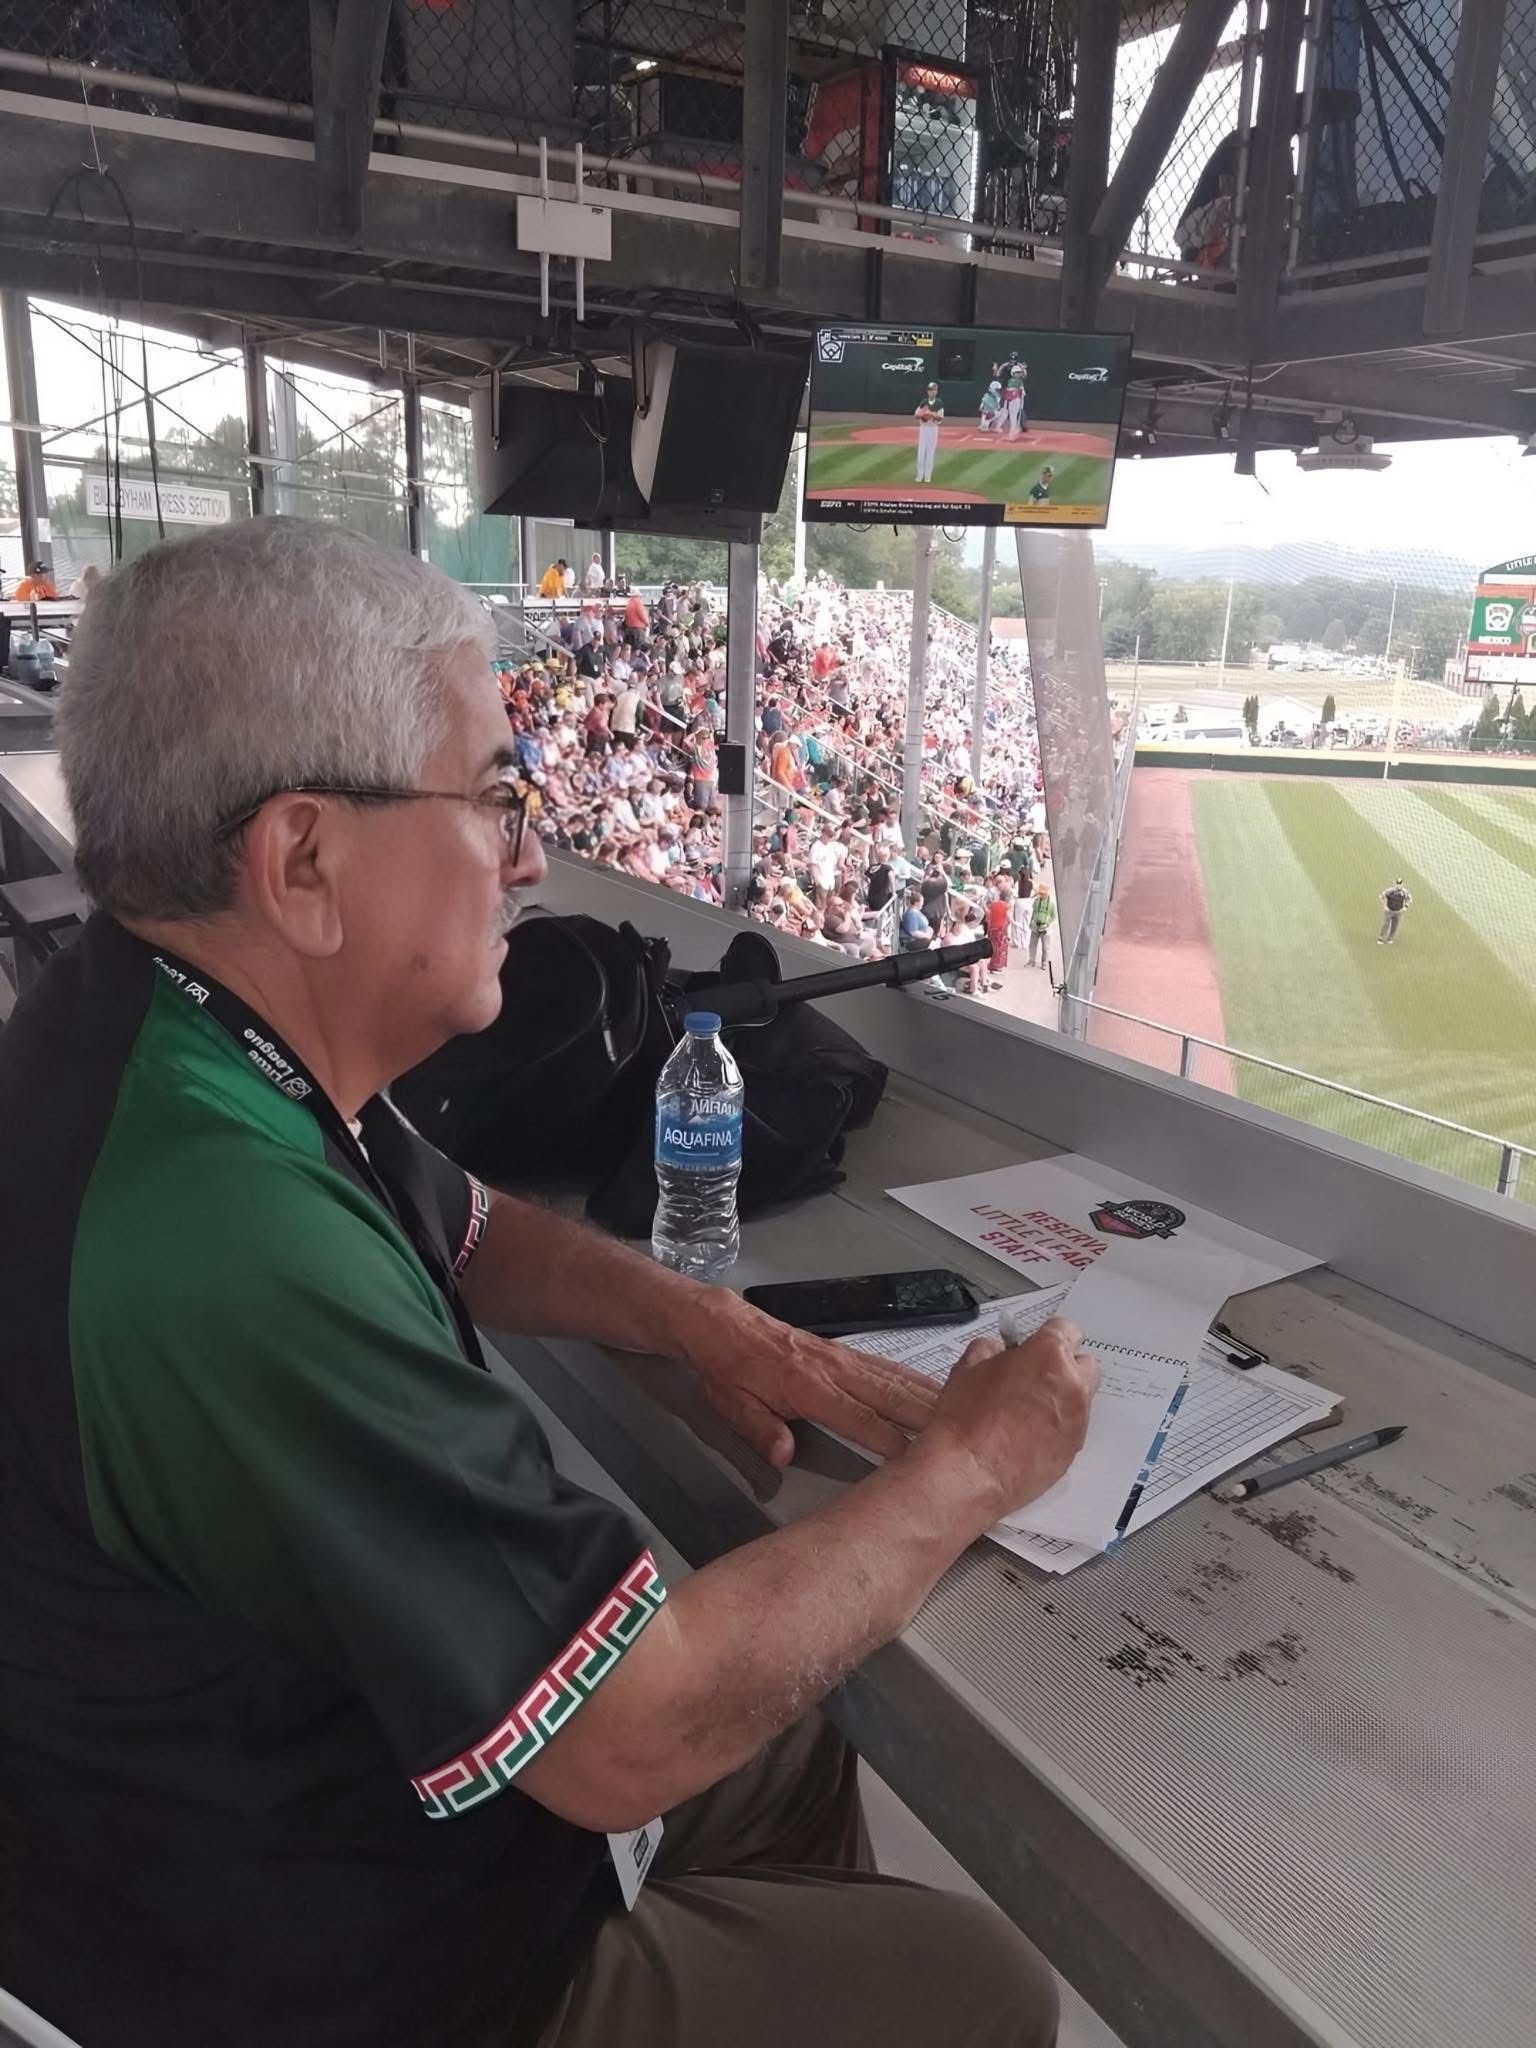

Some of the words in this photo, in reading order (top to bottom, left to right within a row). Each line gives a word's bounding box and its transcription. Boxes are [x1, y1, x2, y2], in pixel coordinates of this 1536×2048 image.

[158, 492, 185, 514] RESS
[189, 495, 226, 518] SECTION
[244, 1028, 294, 1076] League
[664, 1128, 734, 1149] AQUAFINA
[1122, 1206, 1167, 1229] WORLD
[970, 1204, 1044, 1238] LITTLE
[1034, 1239, 1095, 1271] LEAG
[979, 1232, 1051, 1262] STAFF
